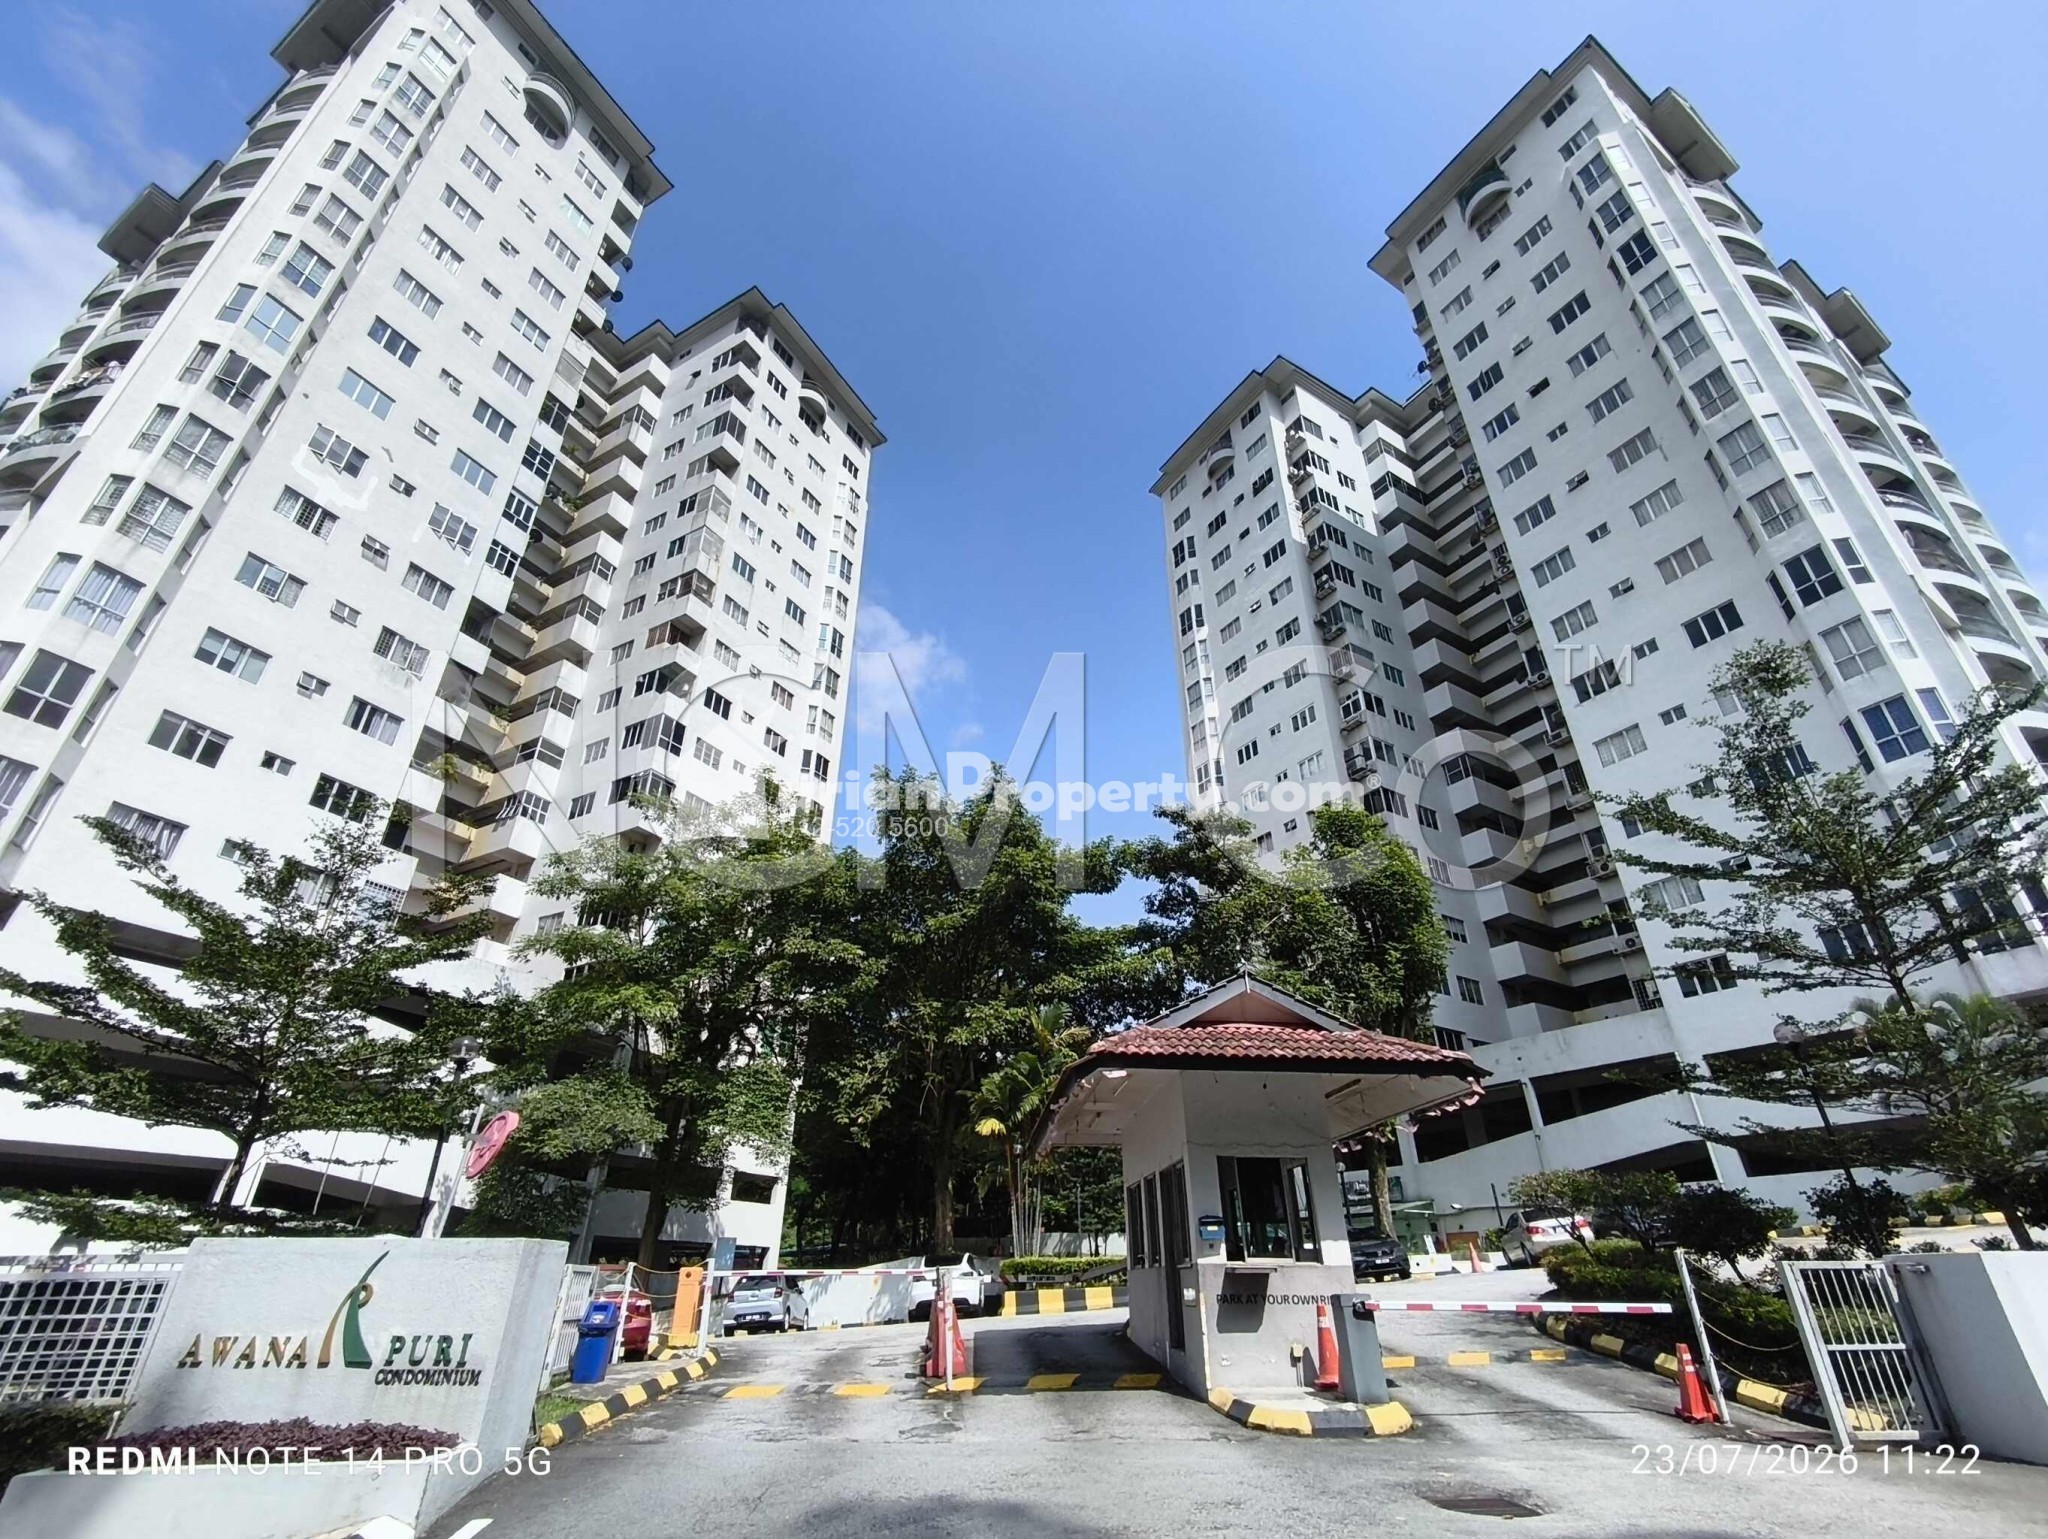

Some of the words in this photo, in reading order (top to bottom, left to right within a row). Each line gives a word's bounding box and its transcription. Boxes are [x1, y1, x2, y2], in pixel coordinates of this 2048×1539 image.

[1216, 1294, 1243, 1306] PARK
[1245, 1294, 1259, 1306] AT
[1260, 1294, 1290, 1306] YOUR
[1291, 1294, 1319, 1306] OWN
[176, 1333, 307, 1369] AWANA
[383, 1333, 473, 1369] PURI
[374, 1368, 482, 1386] CONDOMINIUM
